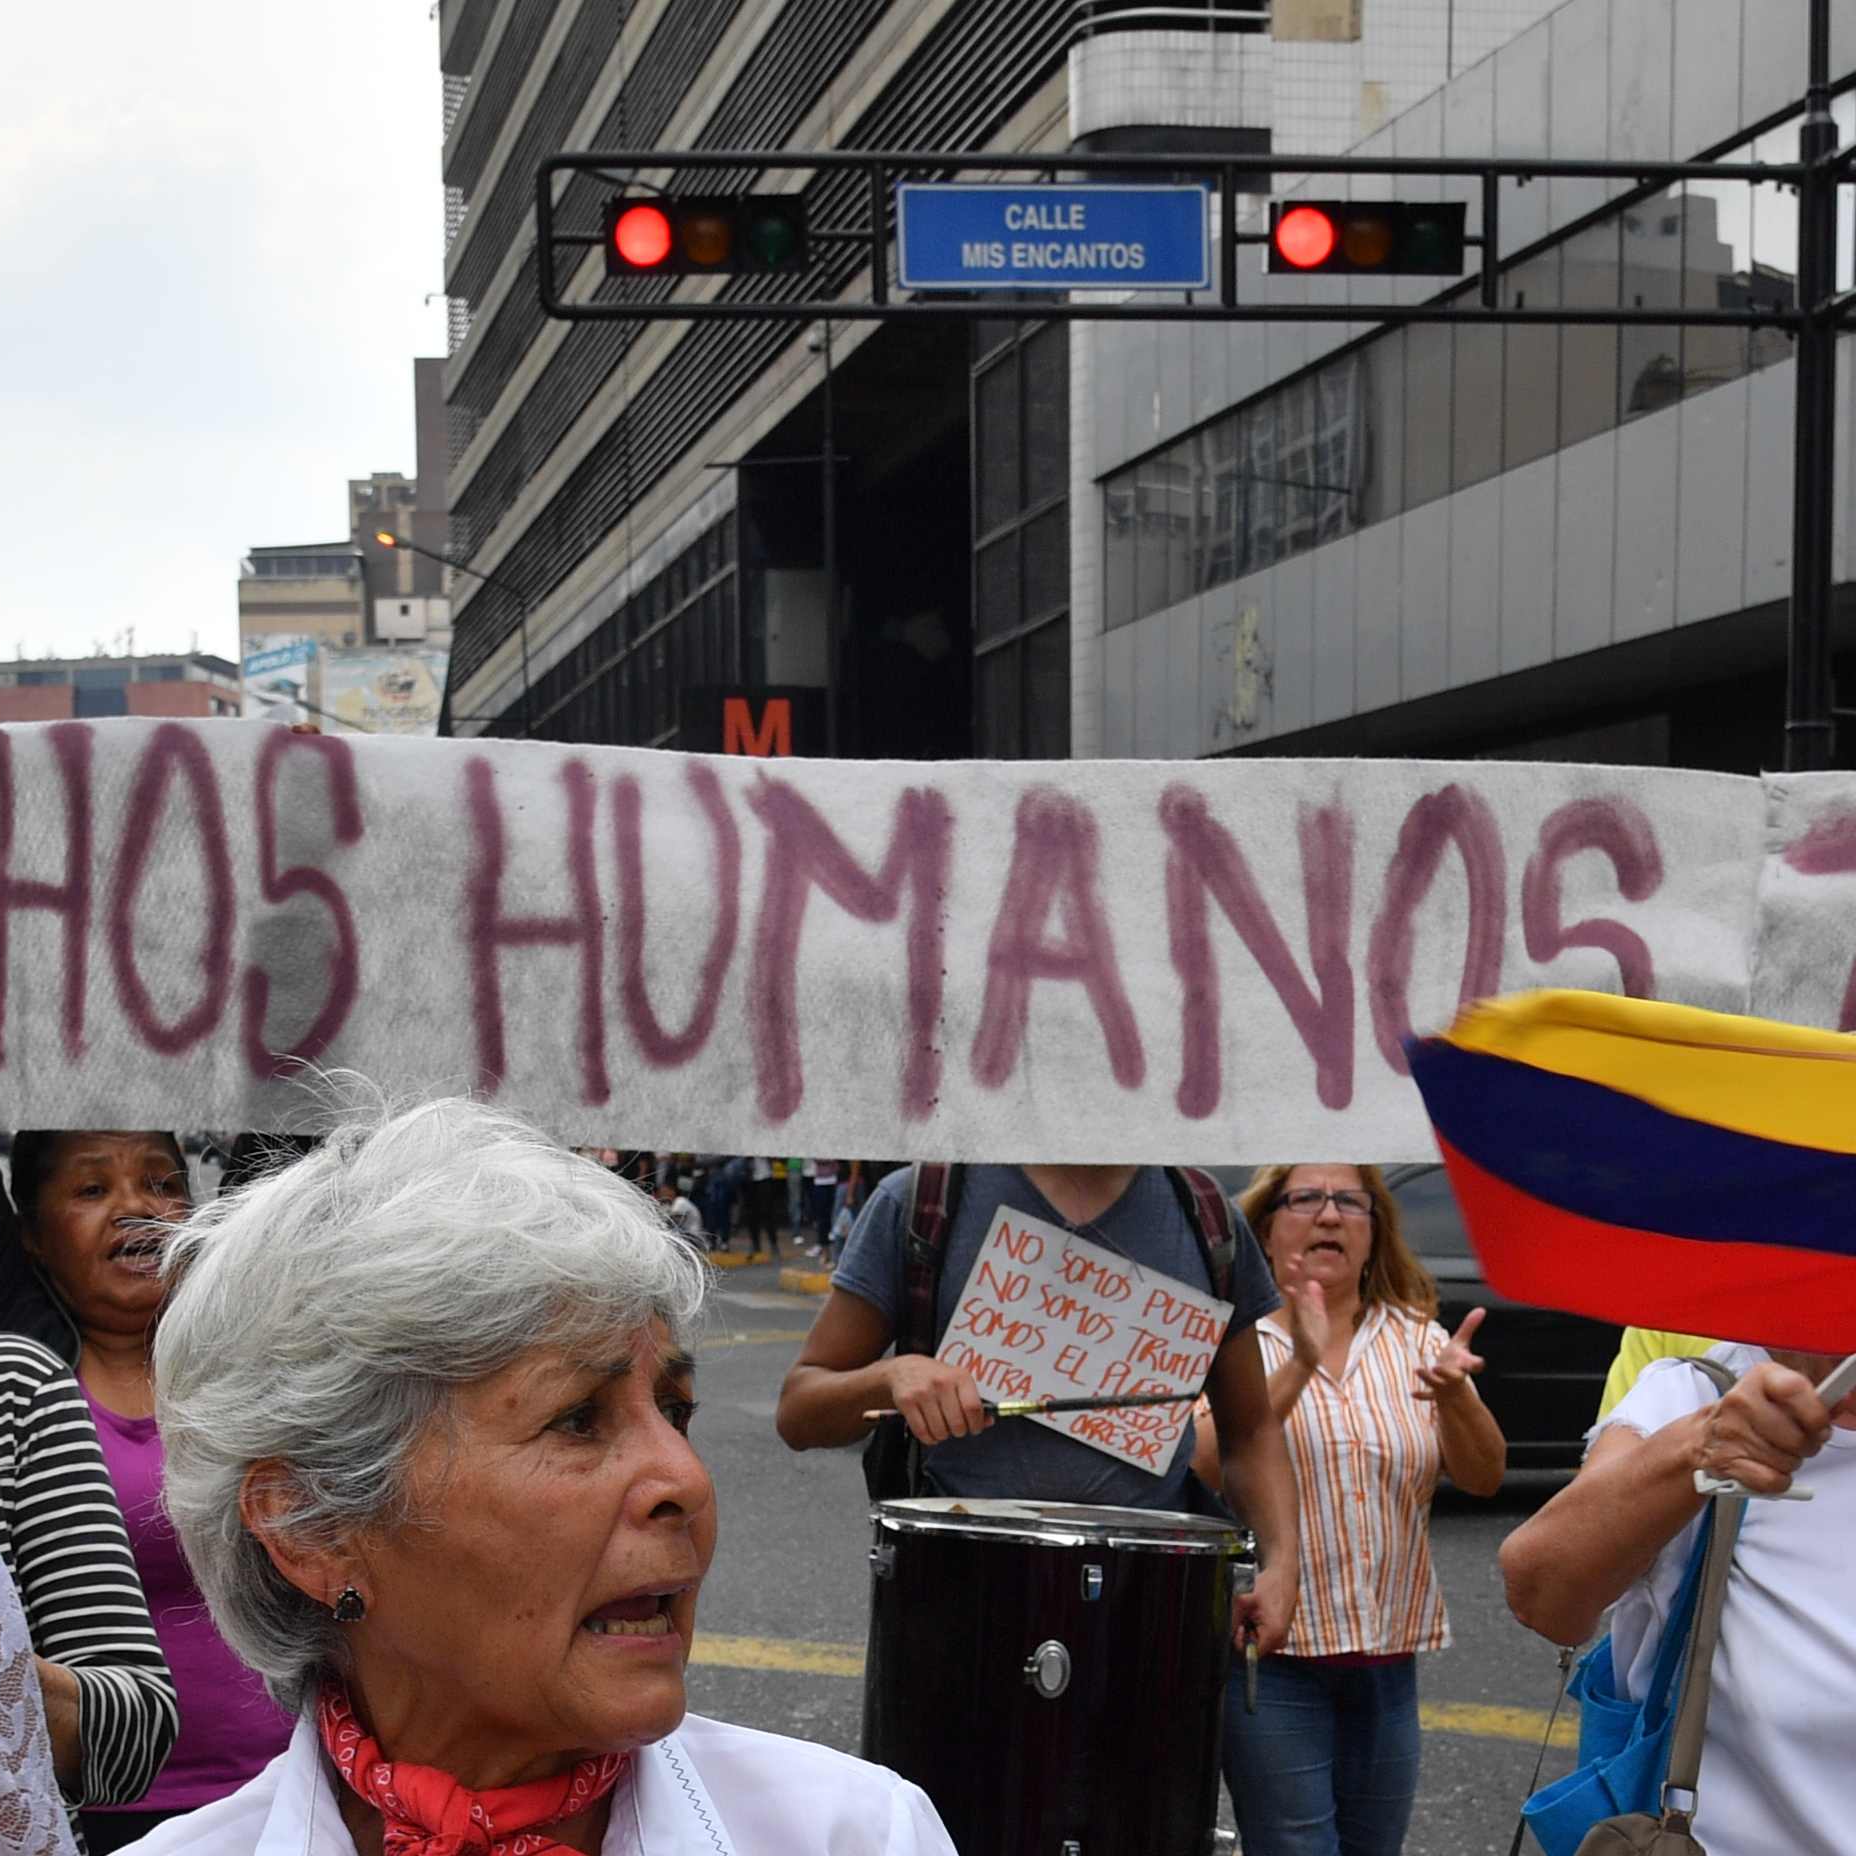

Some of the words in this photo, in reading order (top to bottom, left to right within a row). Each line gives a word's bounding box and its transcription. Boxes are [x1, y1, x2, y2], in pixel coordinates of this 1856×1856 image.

[1005, 204, 1086, 230] CALLE
[961, 243, 1005, 269] MIS
[1012, 243, 1145, 269] ENCANTOS
[724, 698, 791, 757] M
[462, 753, 1661, 1124] HUMANOS
[993, 1221, 1044, 1265] NO
[1054, 1248, 1132, 1302] SOMOS
[953, 1297, 1047, 1356] SOMOS
[1053, 1345, 1090, 1387] EL
[976, 1261, 1030, 1304] NO
[1033, 1283, 1118, 1345] SOMOS
[1127, 1325, 1214, 1388] TRUMP
[940, 1341, 1034, 1400] CONTRA
[1090, 1395, 1180, 1442] NIDO
